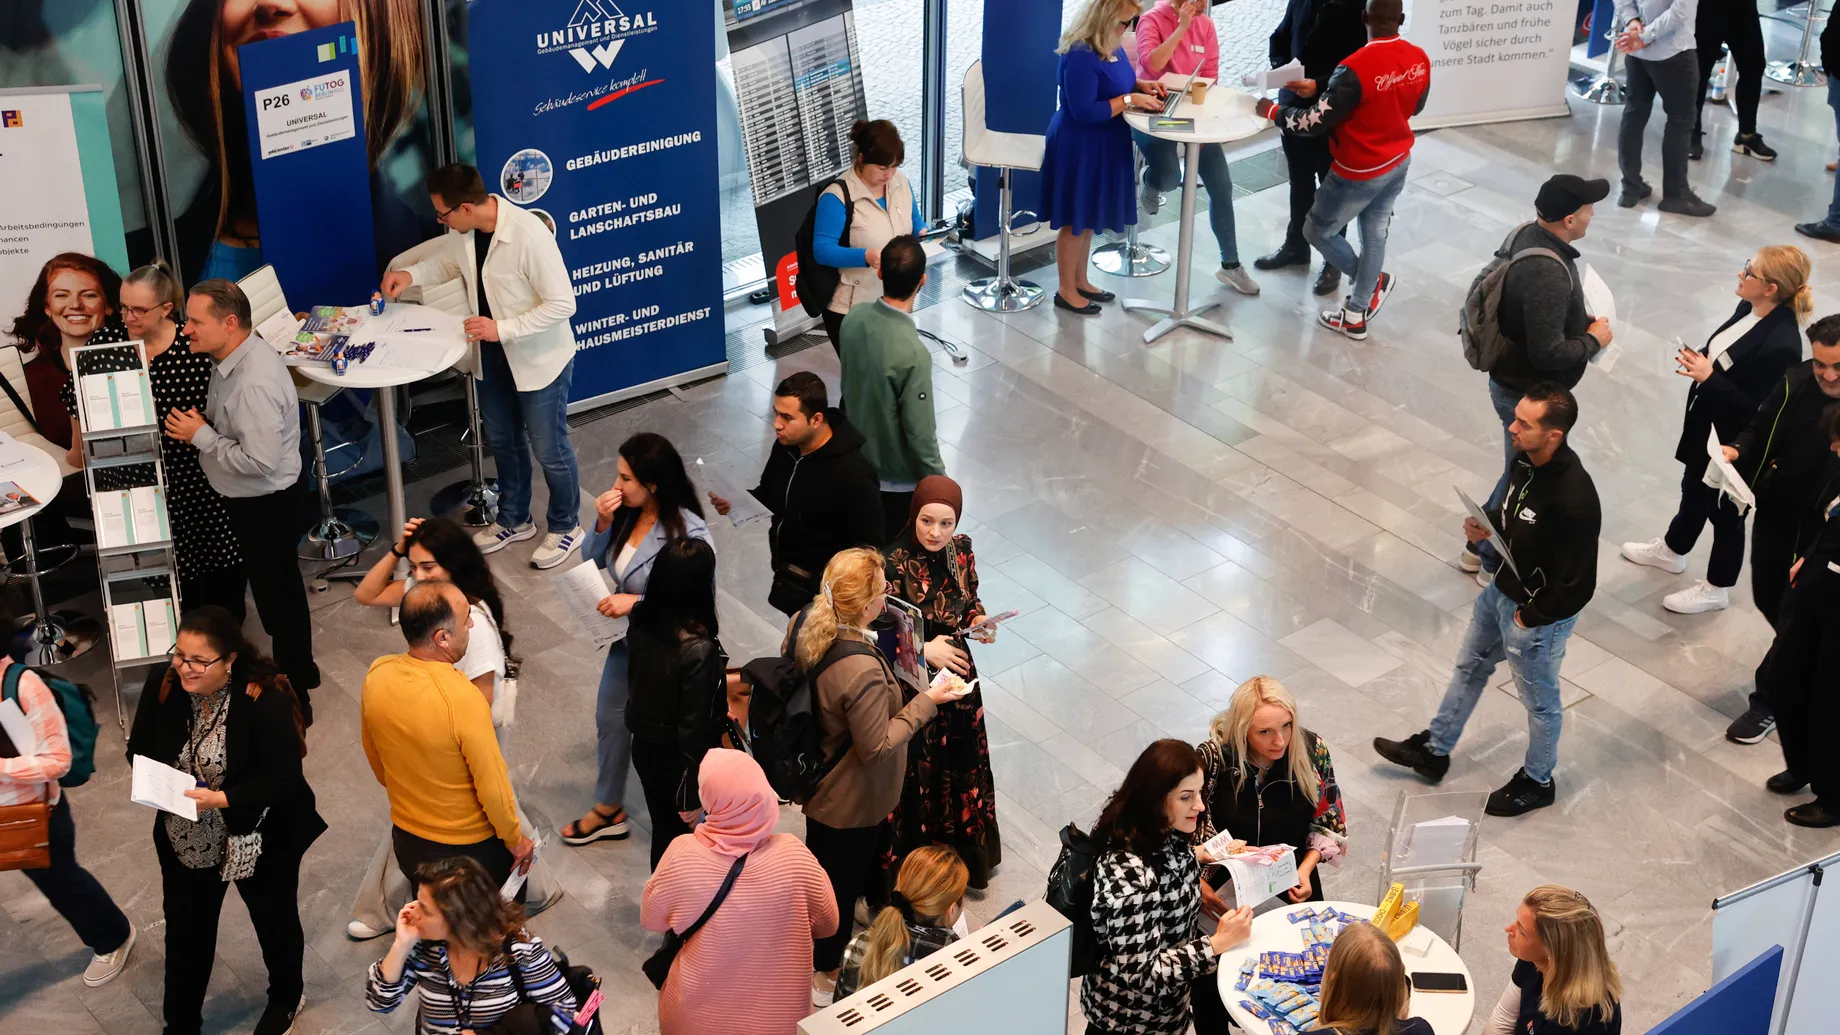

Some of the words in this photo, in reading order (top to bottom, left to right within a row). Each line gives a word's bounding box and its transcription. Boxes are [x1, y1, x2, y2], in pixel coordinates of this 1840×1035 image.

[1439, 21, 1494, 35] Tanzbären
[1495, 17, 1517, 30] und
[1521, 15, 1551, 28] frühe
[1440, 9, 1462, 19] zum
[1466, 5, 1487, 18] Tag.
[1491, 3, 1523, 15] Damit
[1526, 1, 1553, 12] auch
[537, 12, 657, 48] UNIVERSAL
[537, 38, 599, 54] Gebäudemanagement
[600, 34, 610, 42] und
[611, 26, 658, 39] Dienstleistungen
[1443, 38, 1472, 52] Vögel
[1476, 36, 1508, 48] sicher
[1510, 34, 1542, 46] durch
[1467, 51, 1494, 65] Stadt
[263, 94, 290, 111] P26
[314, 78, 344, 93] FUTOG
[286, 111, 327, 127] UNIVERSAL
[566, 131, 701, 171] GEBÄUDEREINIGUNG
[569, 200, 626, 222] GARTEN-
[629, 193, 658, 208] UND
[570, 204, 681, 240] LANSCHAFTSBAU
[572, 256, 634, 280] HEIZUNG,
[638, 241, 694, 263] SANITÄR
[574, 280, 601, 296] UND
[605, 265, 663, 289] LÜFTUNG
[575, 313, 629, 335] WINTER-
[632, 305, 660, 320] UND
[576, 307, 711, 351] HAUSMEISTERDIENST
